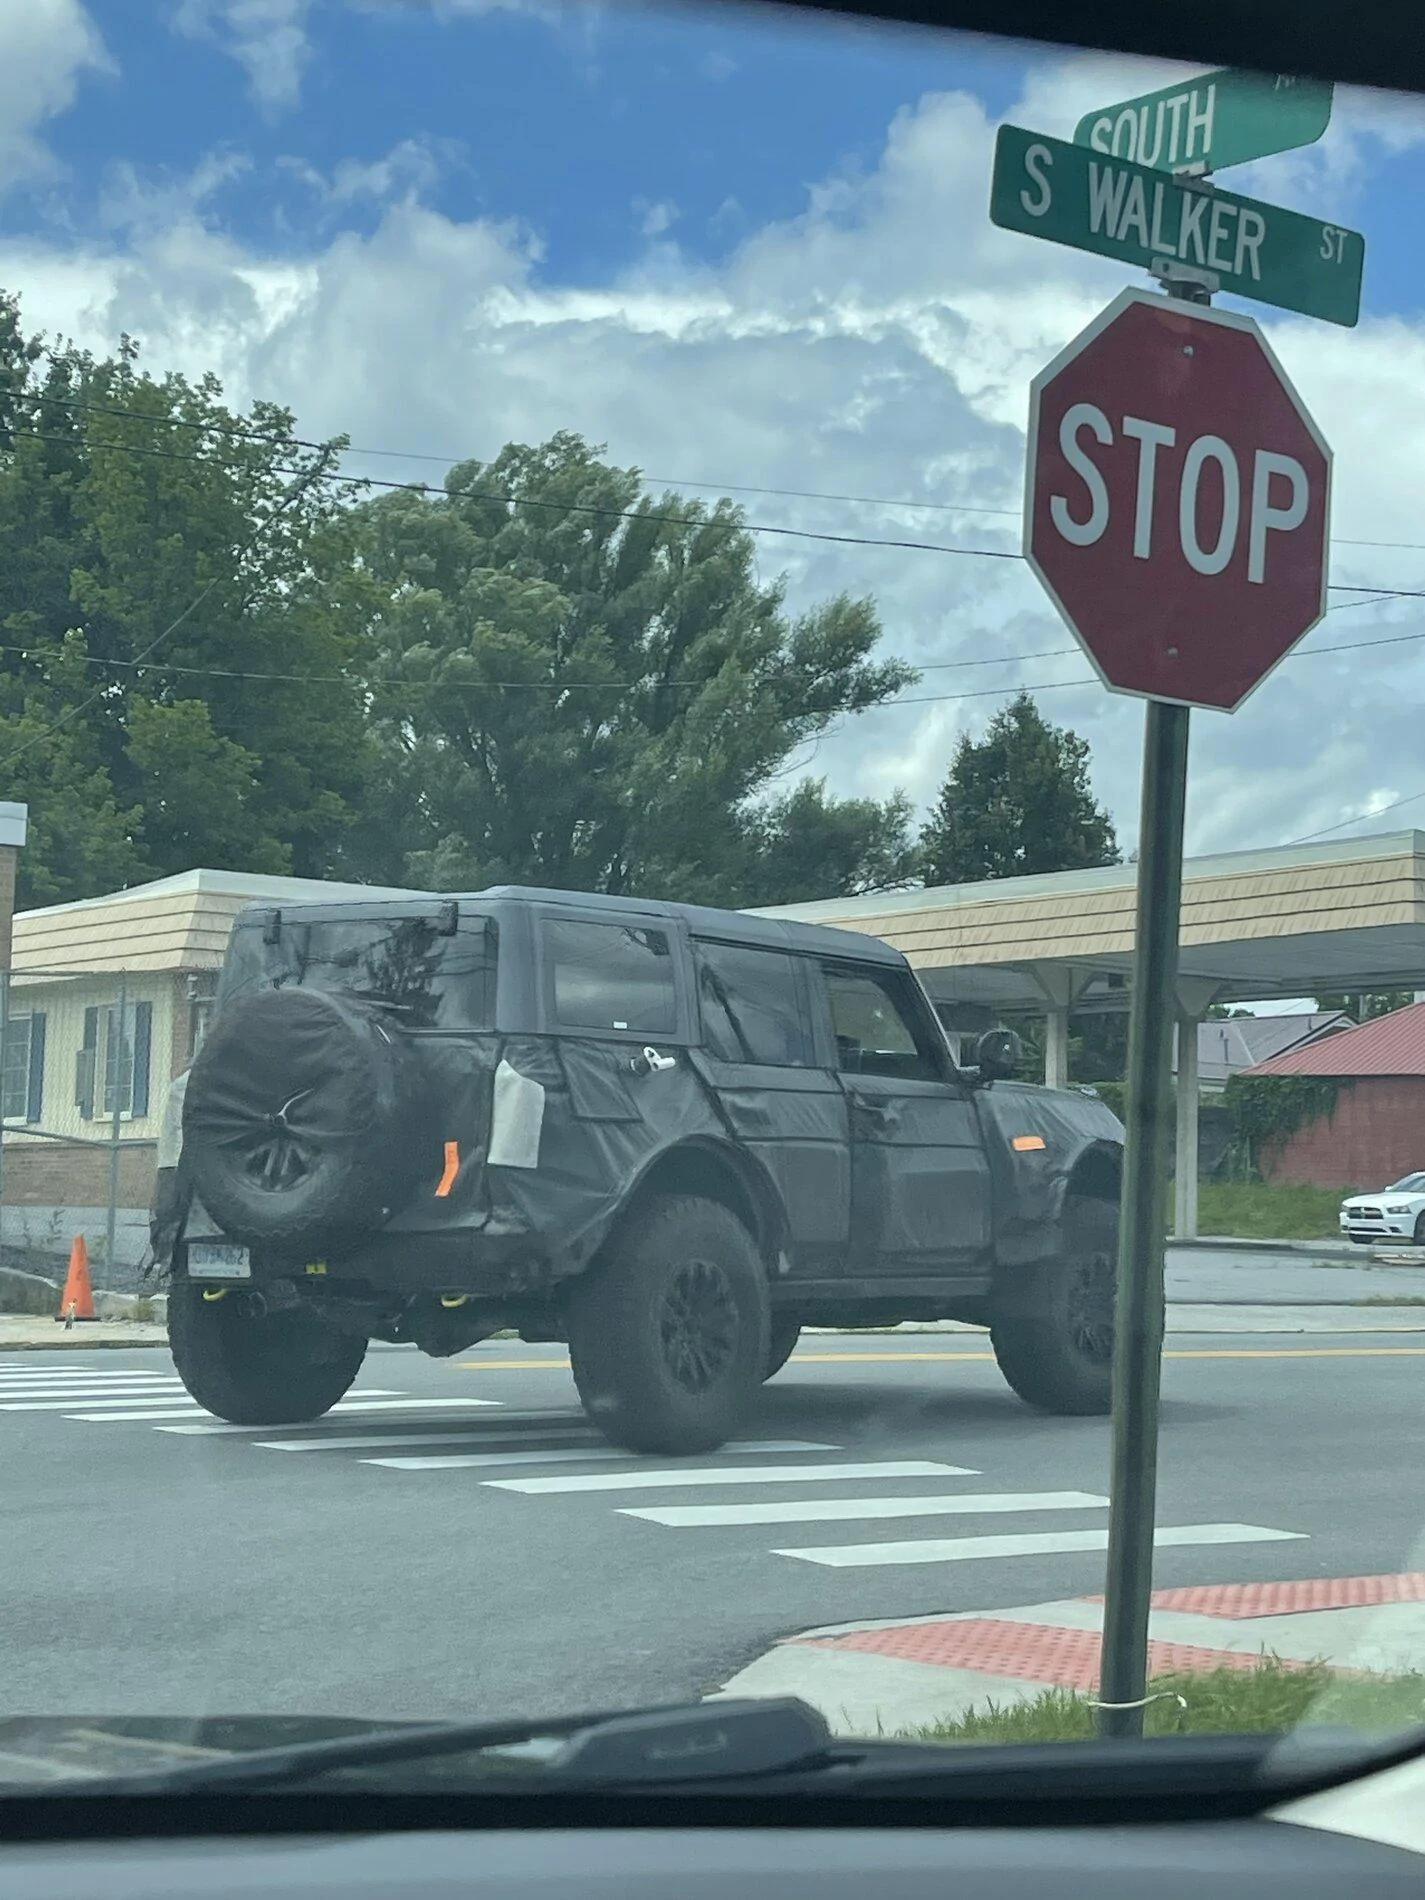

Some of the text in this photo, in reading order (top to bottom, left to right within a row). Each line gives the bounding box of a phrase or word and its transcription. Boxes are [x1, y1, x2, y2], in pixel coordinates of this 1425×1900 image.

[1091, 83, 1215, 167] SOUTH
[1020, 144, 1349, 281] S WALKER ST
[1050, 403, 1310, 584] STOP
